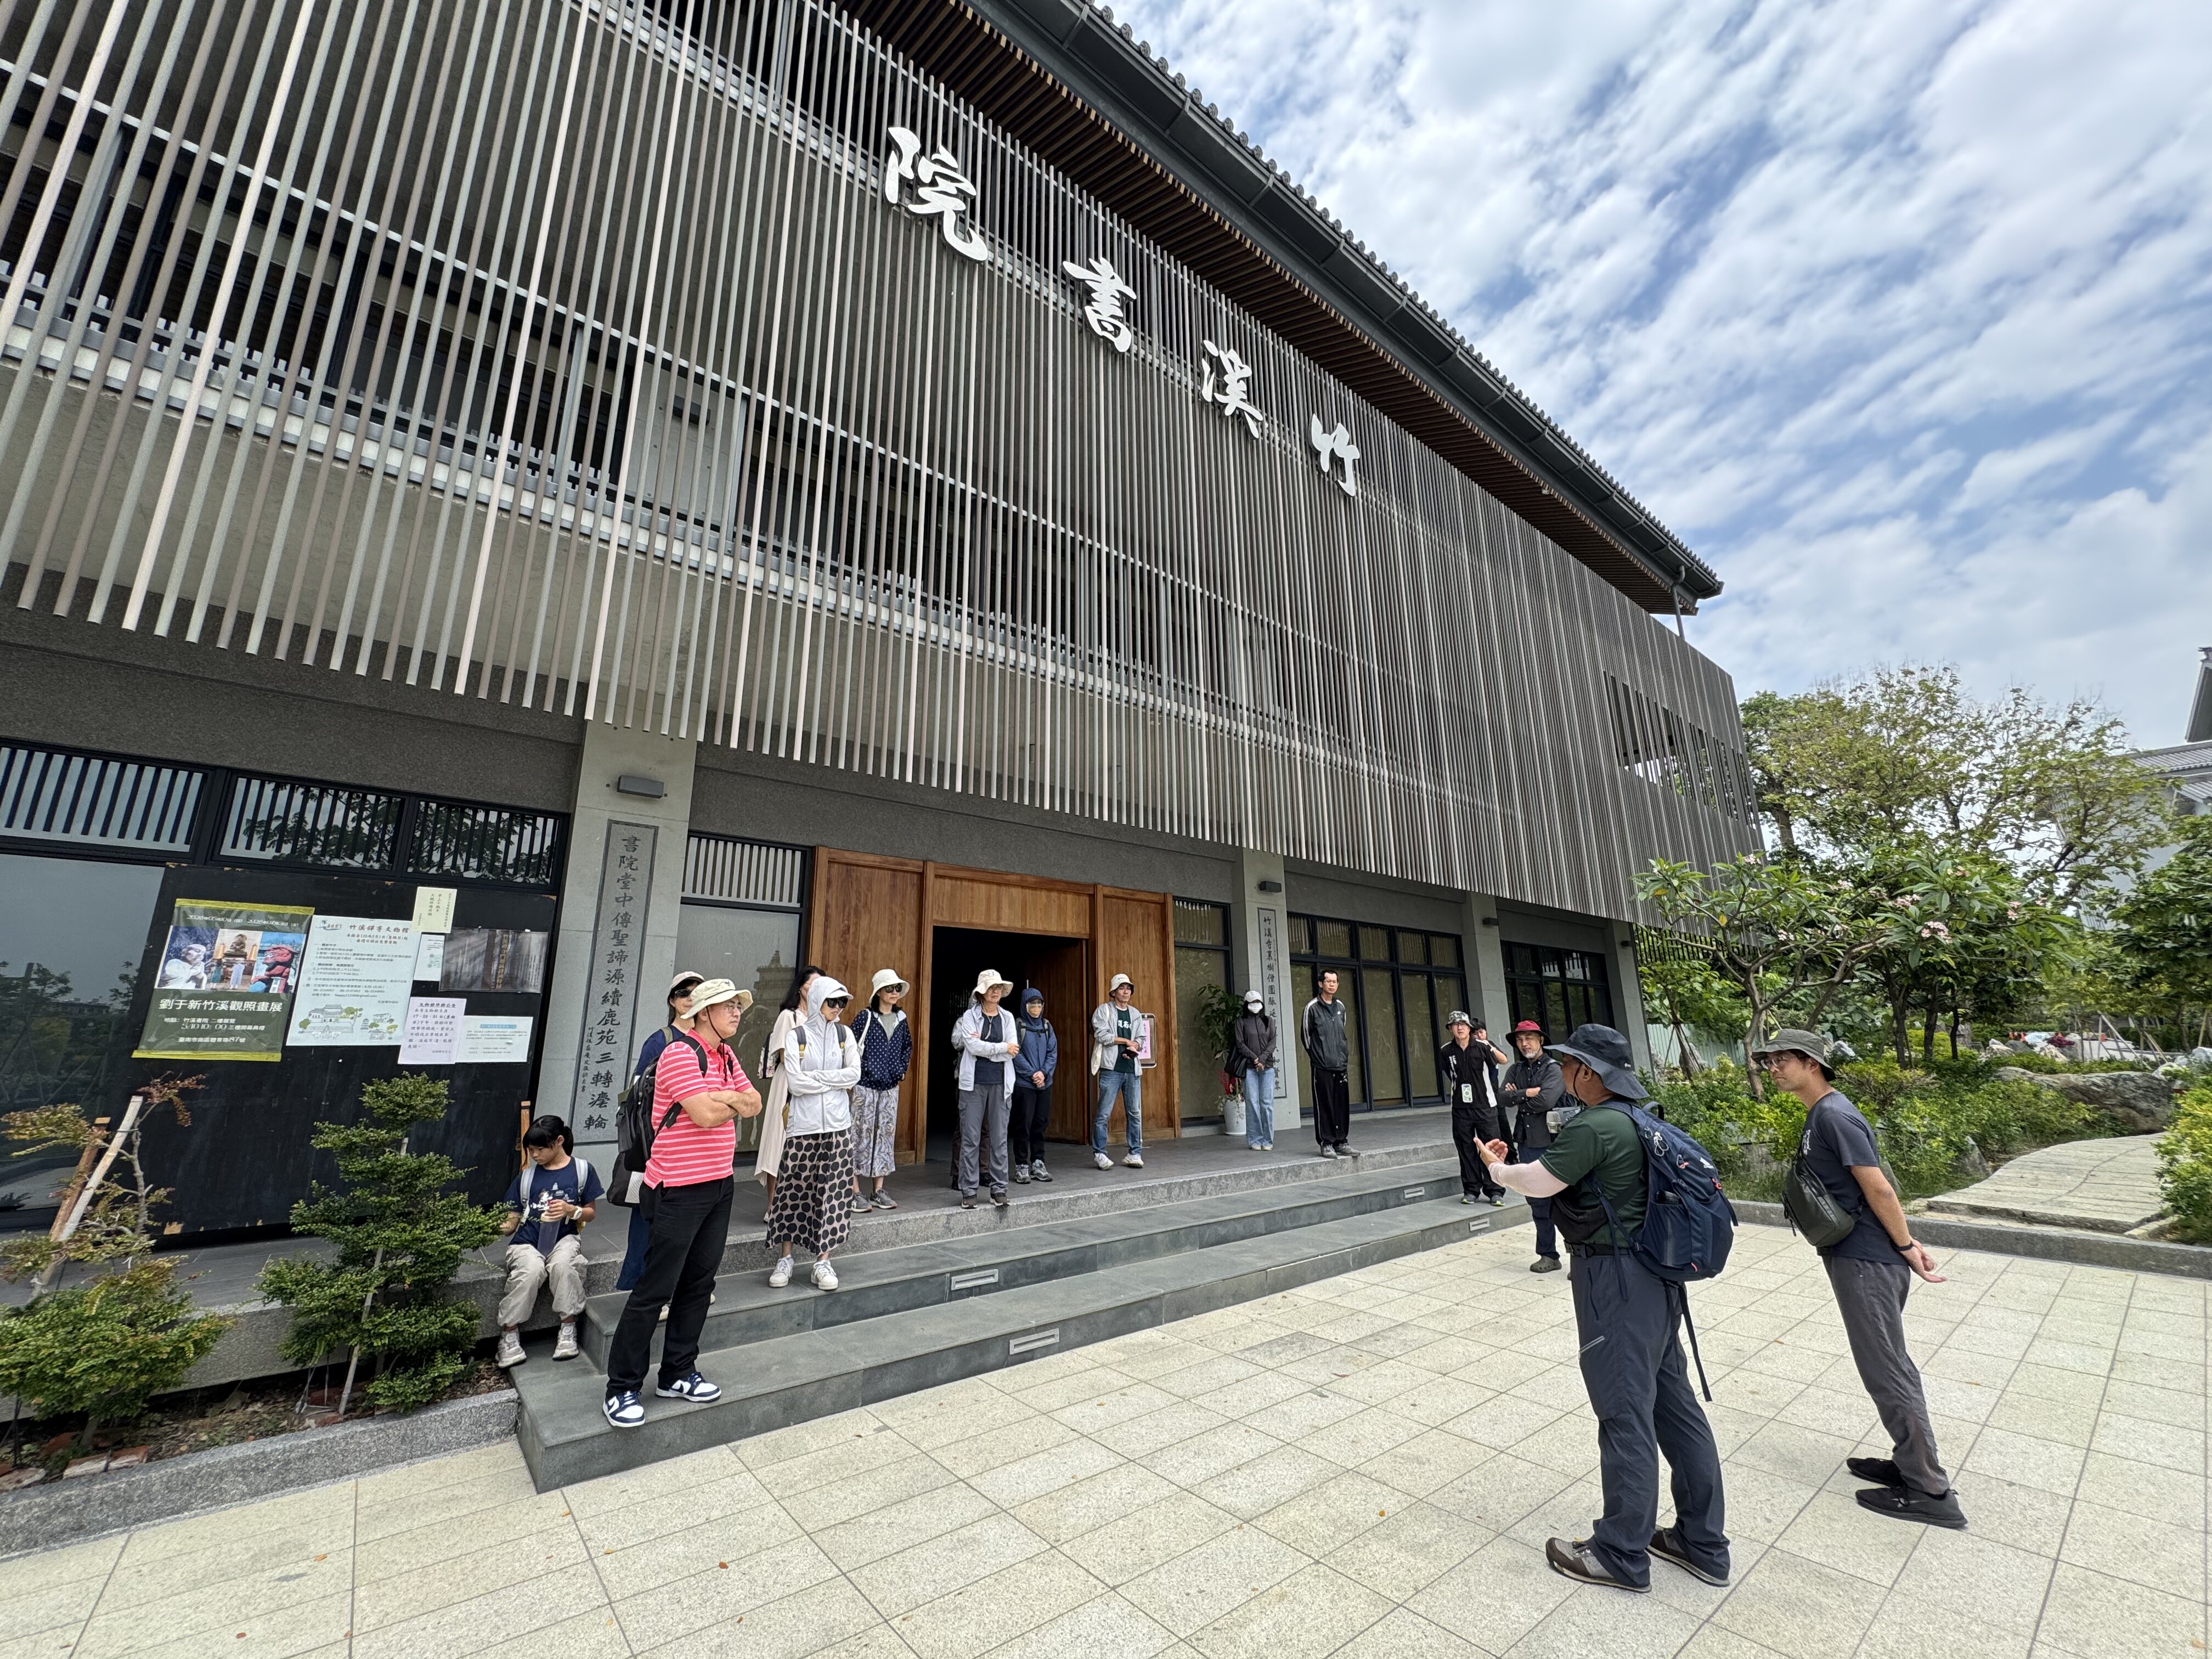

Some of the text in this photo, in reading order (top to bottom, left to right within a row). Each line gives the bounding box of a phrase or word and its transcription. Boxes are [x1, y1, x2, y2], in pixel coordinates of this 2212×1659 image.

[159, 999, 283, 1012] 劉于新竹溪觀照畫展
